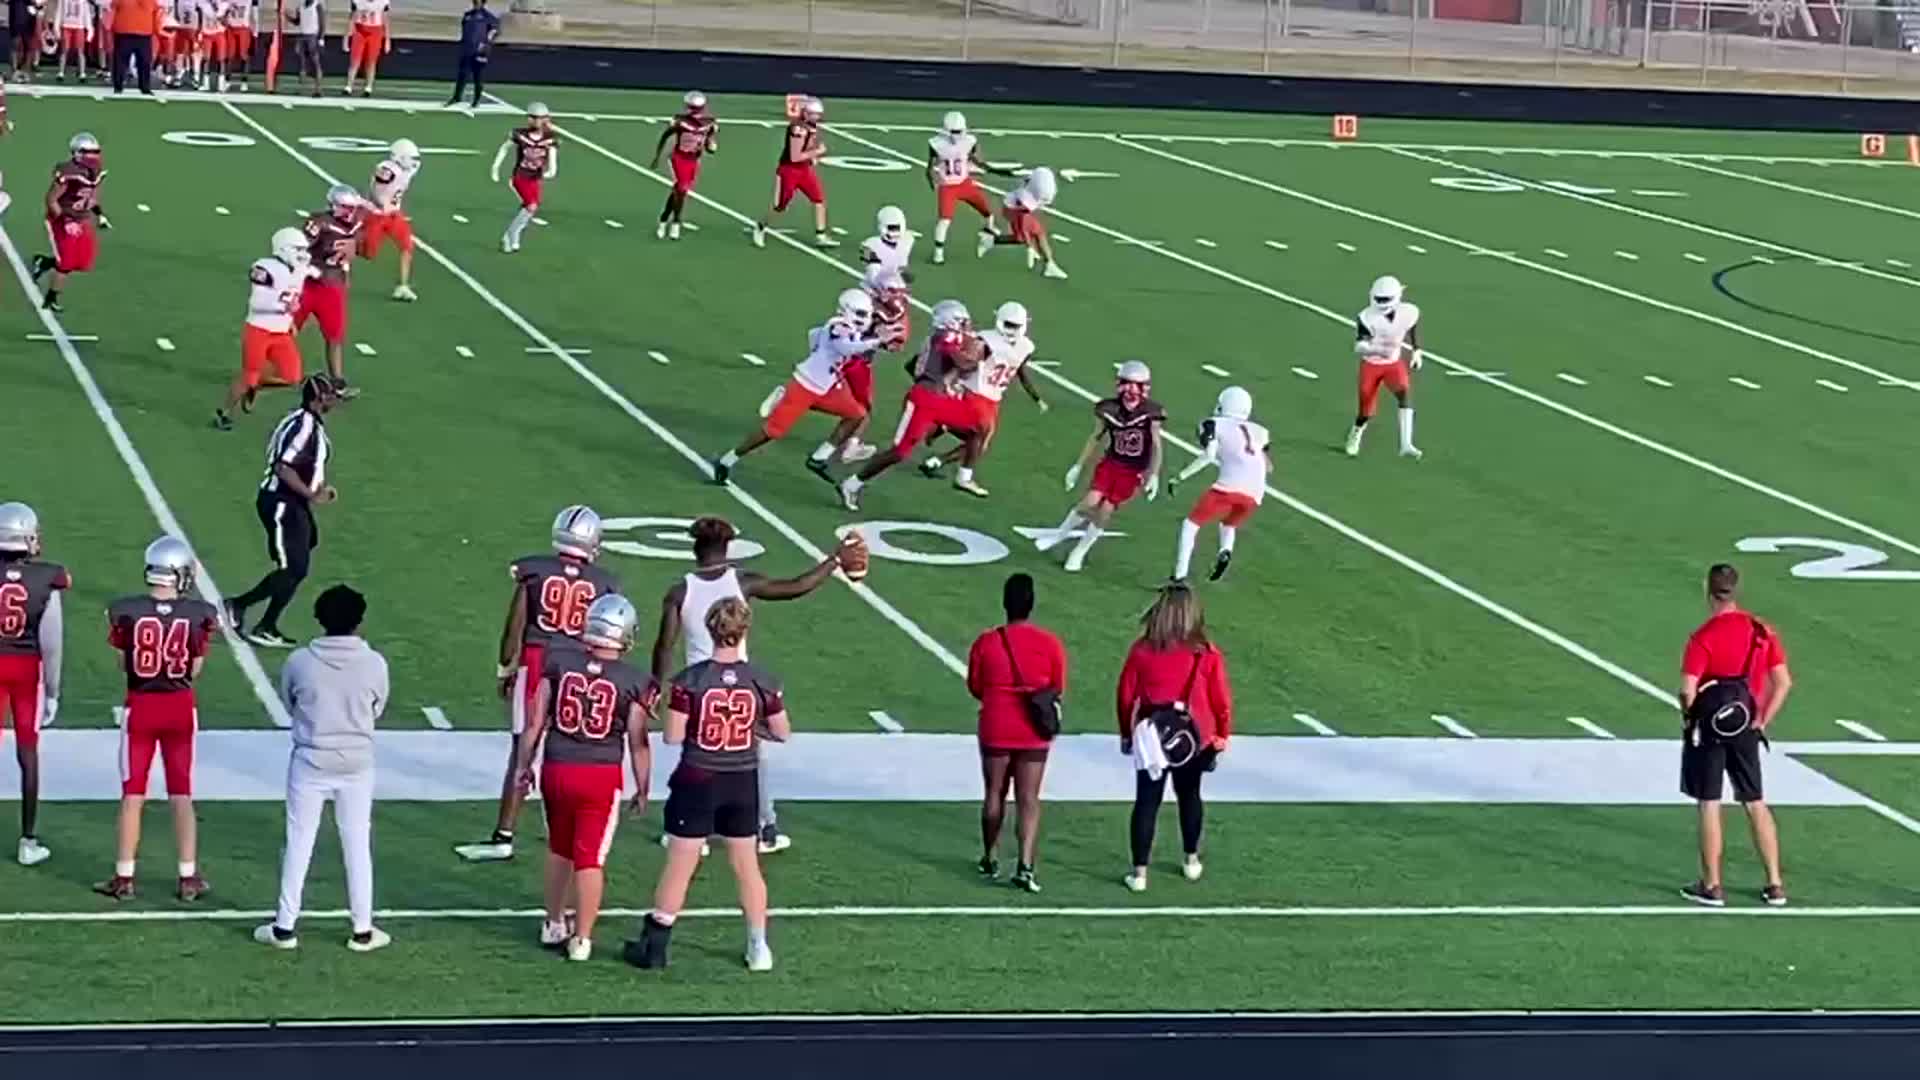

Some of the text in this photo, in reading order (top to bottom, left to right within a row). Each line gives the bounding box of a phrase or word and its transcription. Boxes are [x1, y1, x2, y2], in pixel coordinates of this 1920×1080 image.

[1866, 136, 1881, 154] G
[1238, 423, 1255, 457] 1
[0, 583, 28, 638] 6
[537, 575, 596, 635] 96
[134, 616, 191, 678] 84
[556, 671, 617, 739] 63
[698, 687, 756, 751] 62
